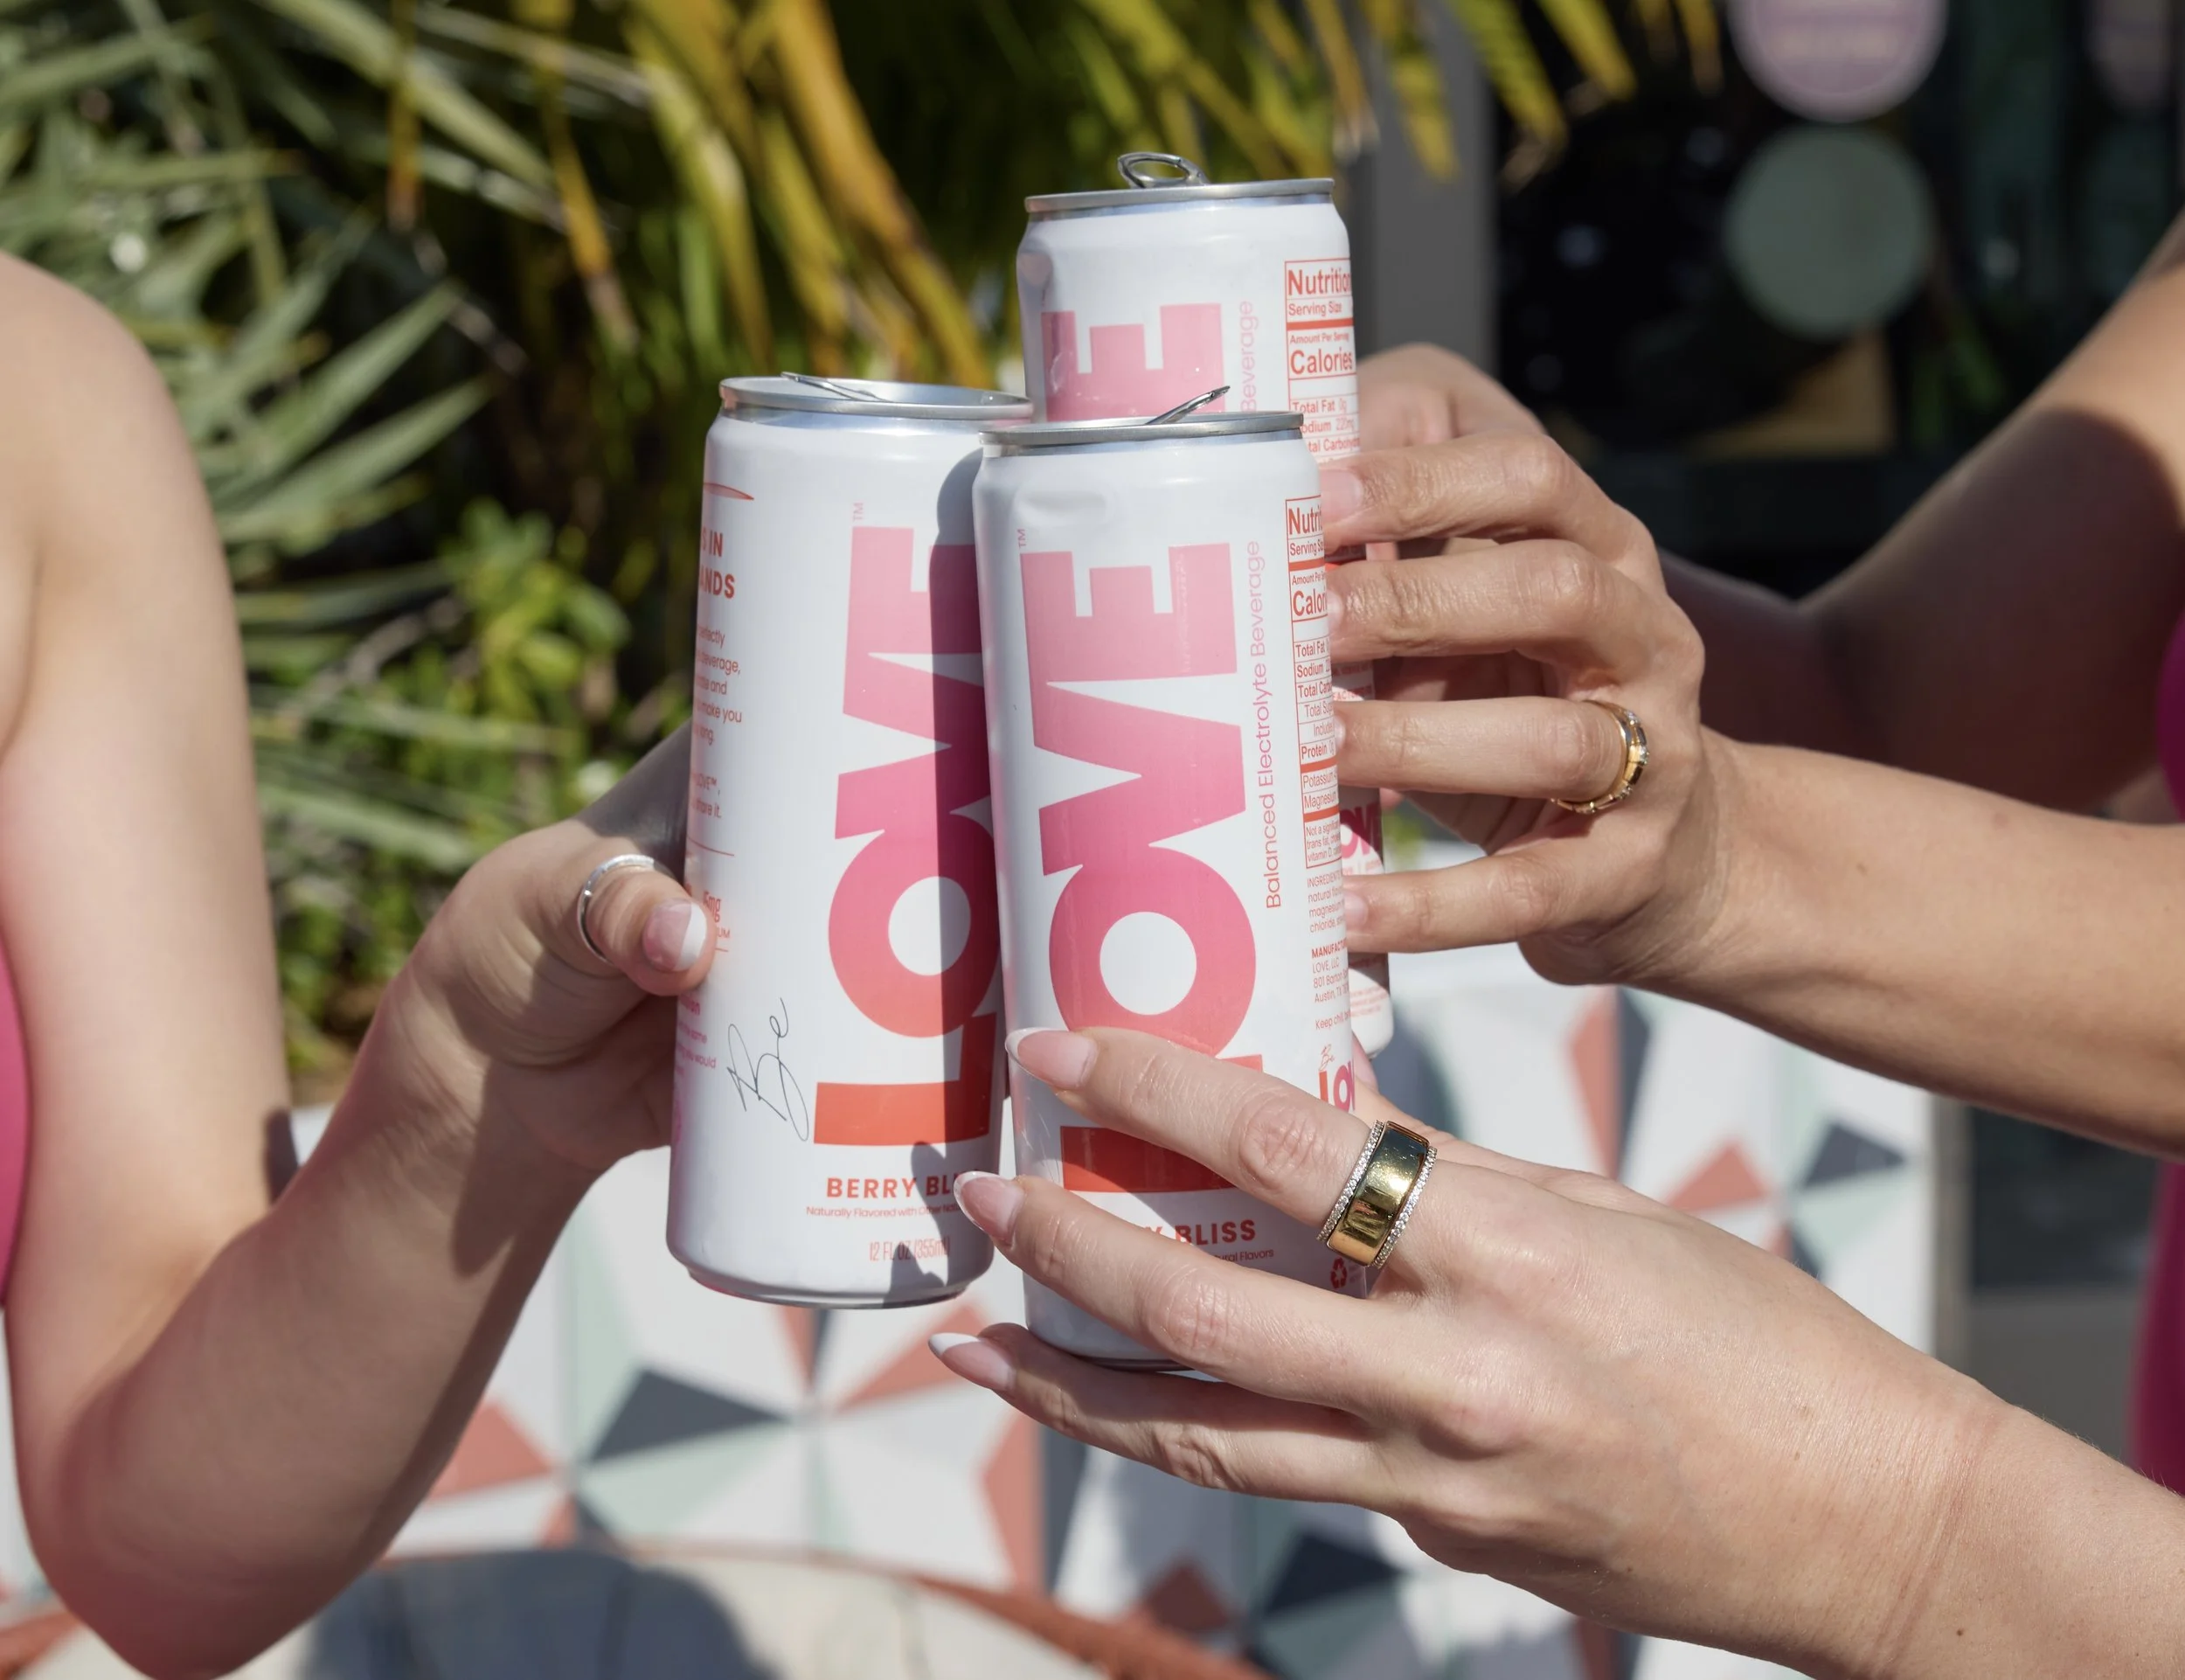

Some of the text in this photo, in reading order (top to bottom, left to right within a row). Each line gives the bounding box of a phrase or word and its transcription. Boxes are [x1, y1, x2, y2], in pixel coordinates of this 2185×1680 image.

[1288, 301, 1342, 316] Serving Size
[1290, 333, 1321, 344] Amount
[1321, 332, 1332, 342] Per
[1238, 301, 1259, 413] Beverage
[1290, 346, 1353, 374] Calories
[1293, 401, 1319, 413] Total
[1321, 399, 1335, 412] Fat
[1302, 420, 1331, 433] odium
[709, 530, 723, 557] IN
[1289, 541, 1317, 557] Serving
[1292, 574, 1314, 586] Amount
[1295, 642, 1315, 657] Total
[1317, 640, 1326, 656] Fat
[1297, 662, 1323, 678] Sodium
[711, 681, 727, 695] and
[1298, 683, 1318, 698] Total
[723, 708, 742, 724] you
[1304, 701, 1321, 718] Total
[1247, 541, 1281, 908] Balanced Electrolyte Beverage
[1301, 743, 1327, 760] Protein
[1306, 824, 1317, 837] Not
[1307, 838, 1321, 850] trans
[1307, 850, 1328, 863] vitamin
[1308, 890, 1330, 903] natural
[1314, 975, 1324, 989] 801
[1315, 1017, 1333, 1031] Keep
[826, 1177, 917, 1198] BERRY
[806, 1205, 852, 1219] Naturally
[854, 1207, 896, 1218] Flavored
[898, 1206, 917, 1217] with
[1175, 1218, 1256, 1246] BLISS
[869, 1241, 880, 1262] 12
[898, 1239, 912, 1260] OZ
[1239, 1248, 1274, 1261] Flavors
